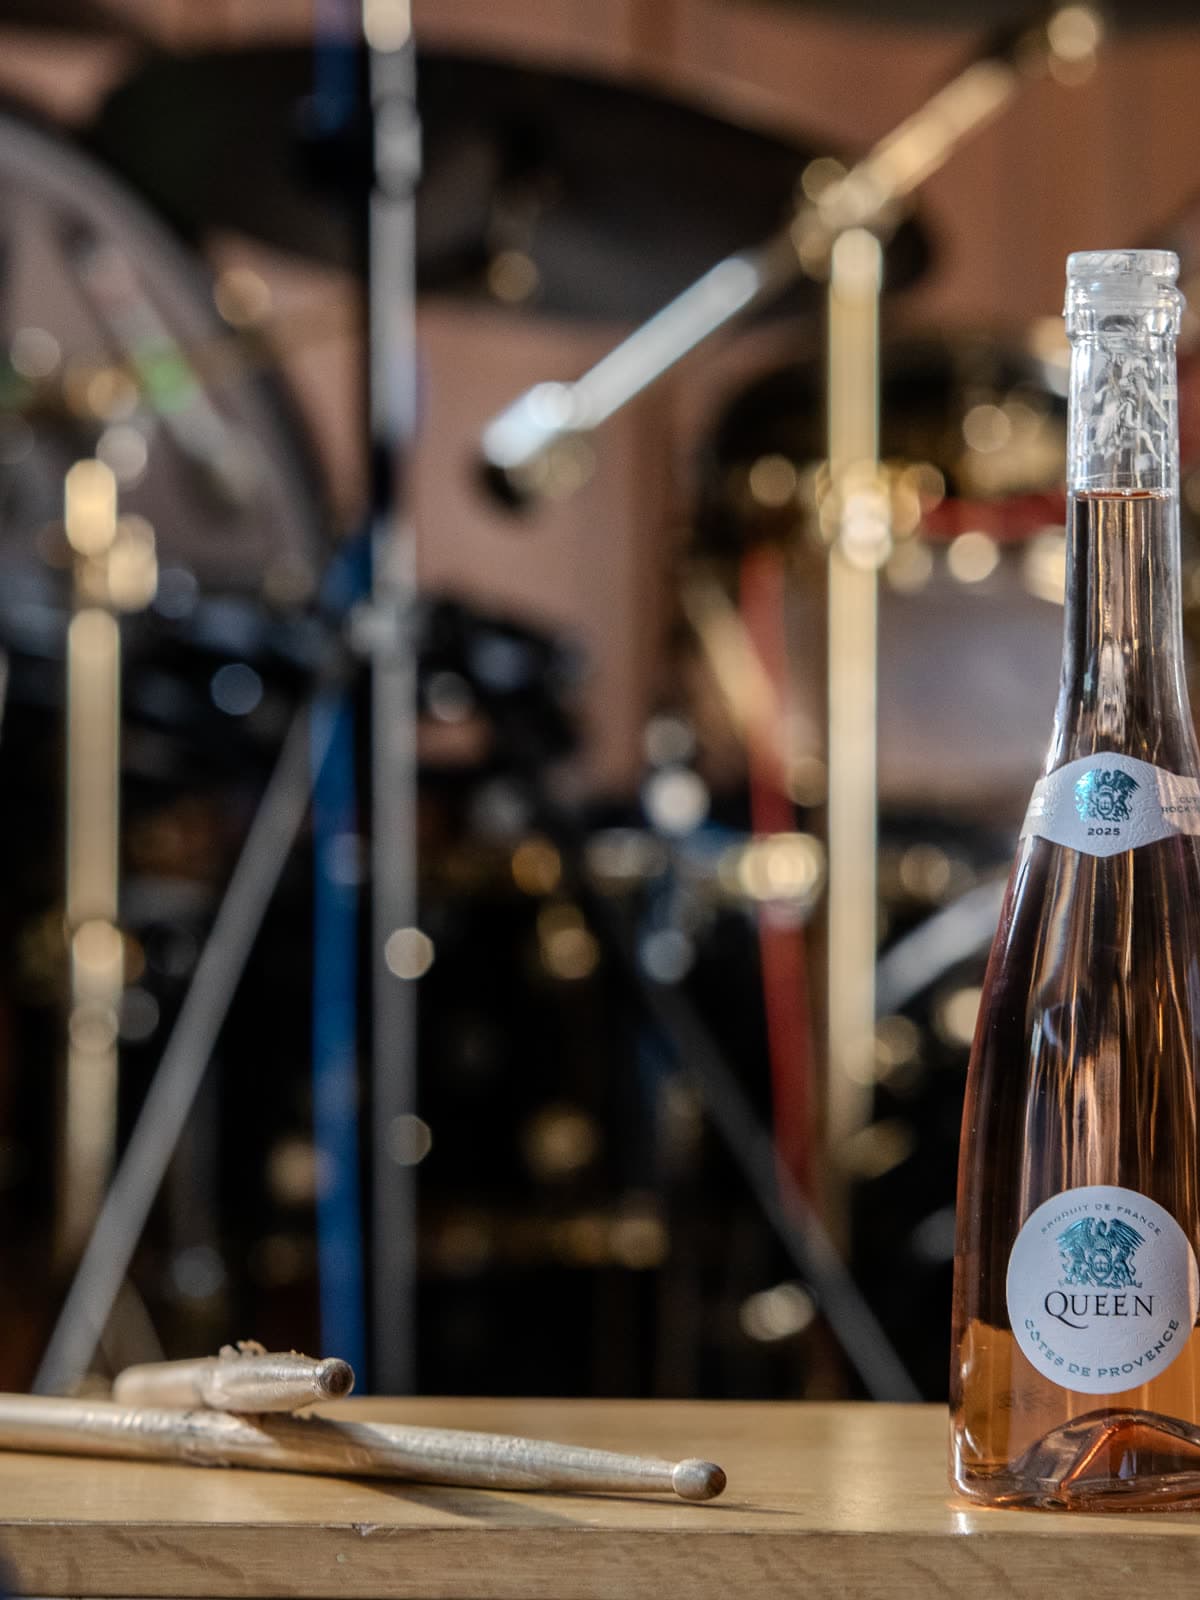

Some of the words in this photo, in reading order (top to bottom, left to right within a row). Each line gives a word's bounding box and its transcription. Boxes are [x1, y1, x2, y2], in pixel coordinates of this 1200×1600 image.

[1087, 827, 1121, 836] 2025
[1095, 1203, 1112, 1211] DE
[1117, 1206, 1162, 1236] FRANCE
[1044, 1291, 1155, 1330] QUEEN
[1068, 1363, 1092, 1377] DE
[1098, 1319, 1179, 1378] PROVENCE
